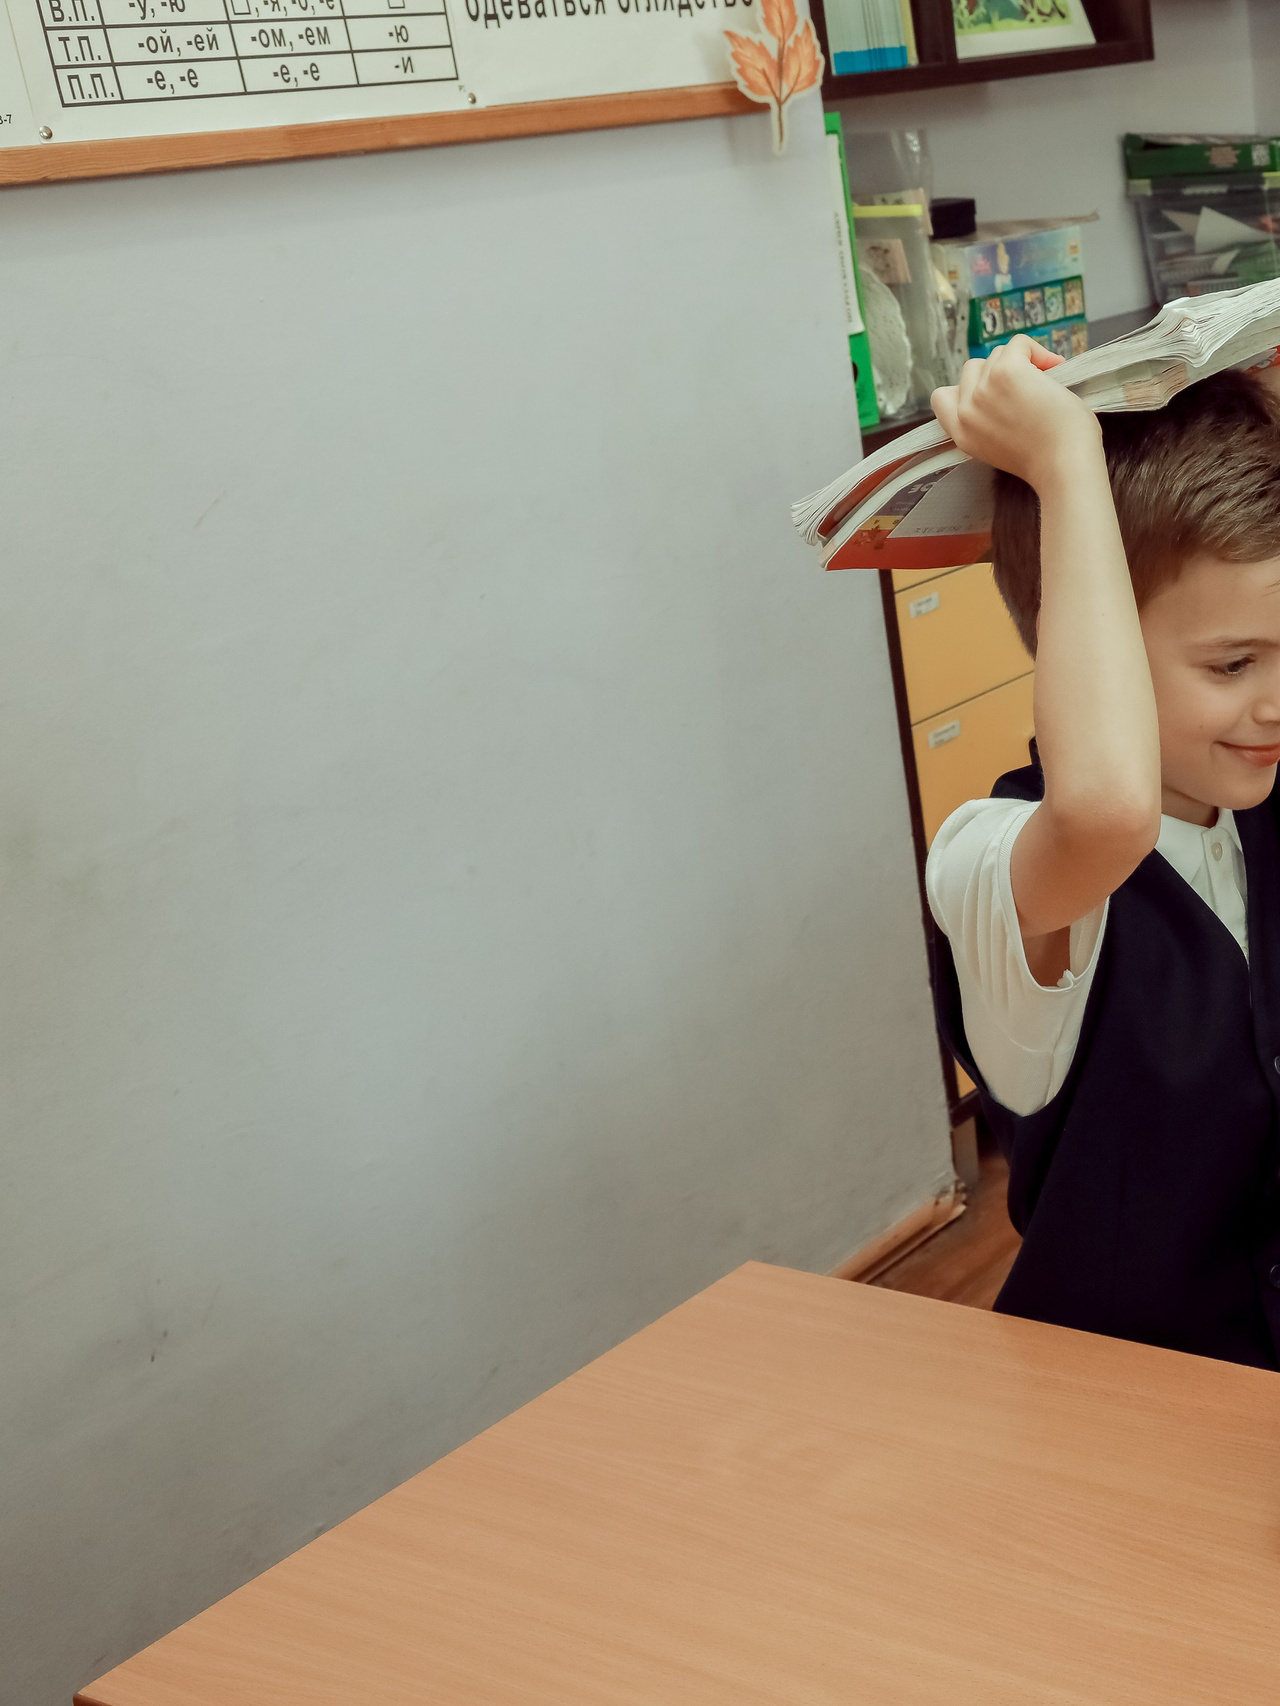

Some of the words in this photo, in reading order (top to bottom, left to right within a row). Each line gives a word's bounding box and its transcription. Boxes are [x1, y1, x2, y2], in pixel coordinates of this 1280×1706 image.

[48, 0, 95, 22] В.П.
[138, 29, 181, 57] -ой,
[187, 27, 219, 52] -ей
[251, 28, 294, 52] -ом,
[298, 26, 331, 46] -ем
[388, 25, 409, 43] -ю
[58, 36, 102, 62] Т.П.
[273, 64, 298, 87] -е,
[303, 62, 320, 81] -е
[394, 56, 414, 74] -и
[67, 73, 115, 100] П.П.
[147, 70, 175, 95] -е,
[180, 69, 199, 88] -е
